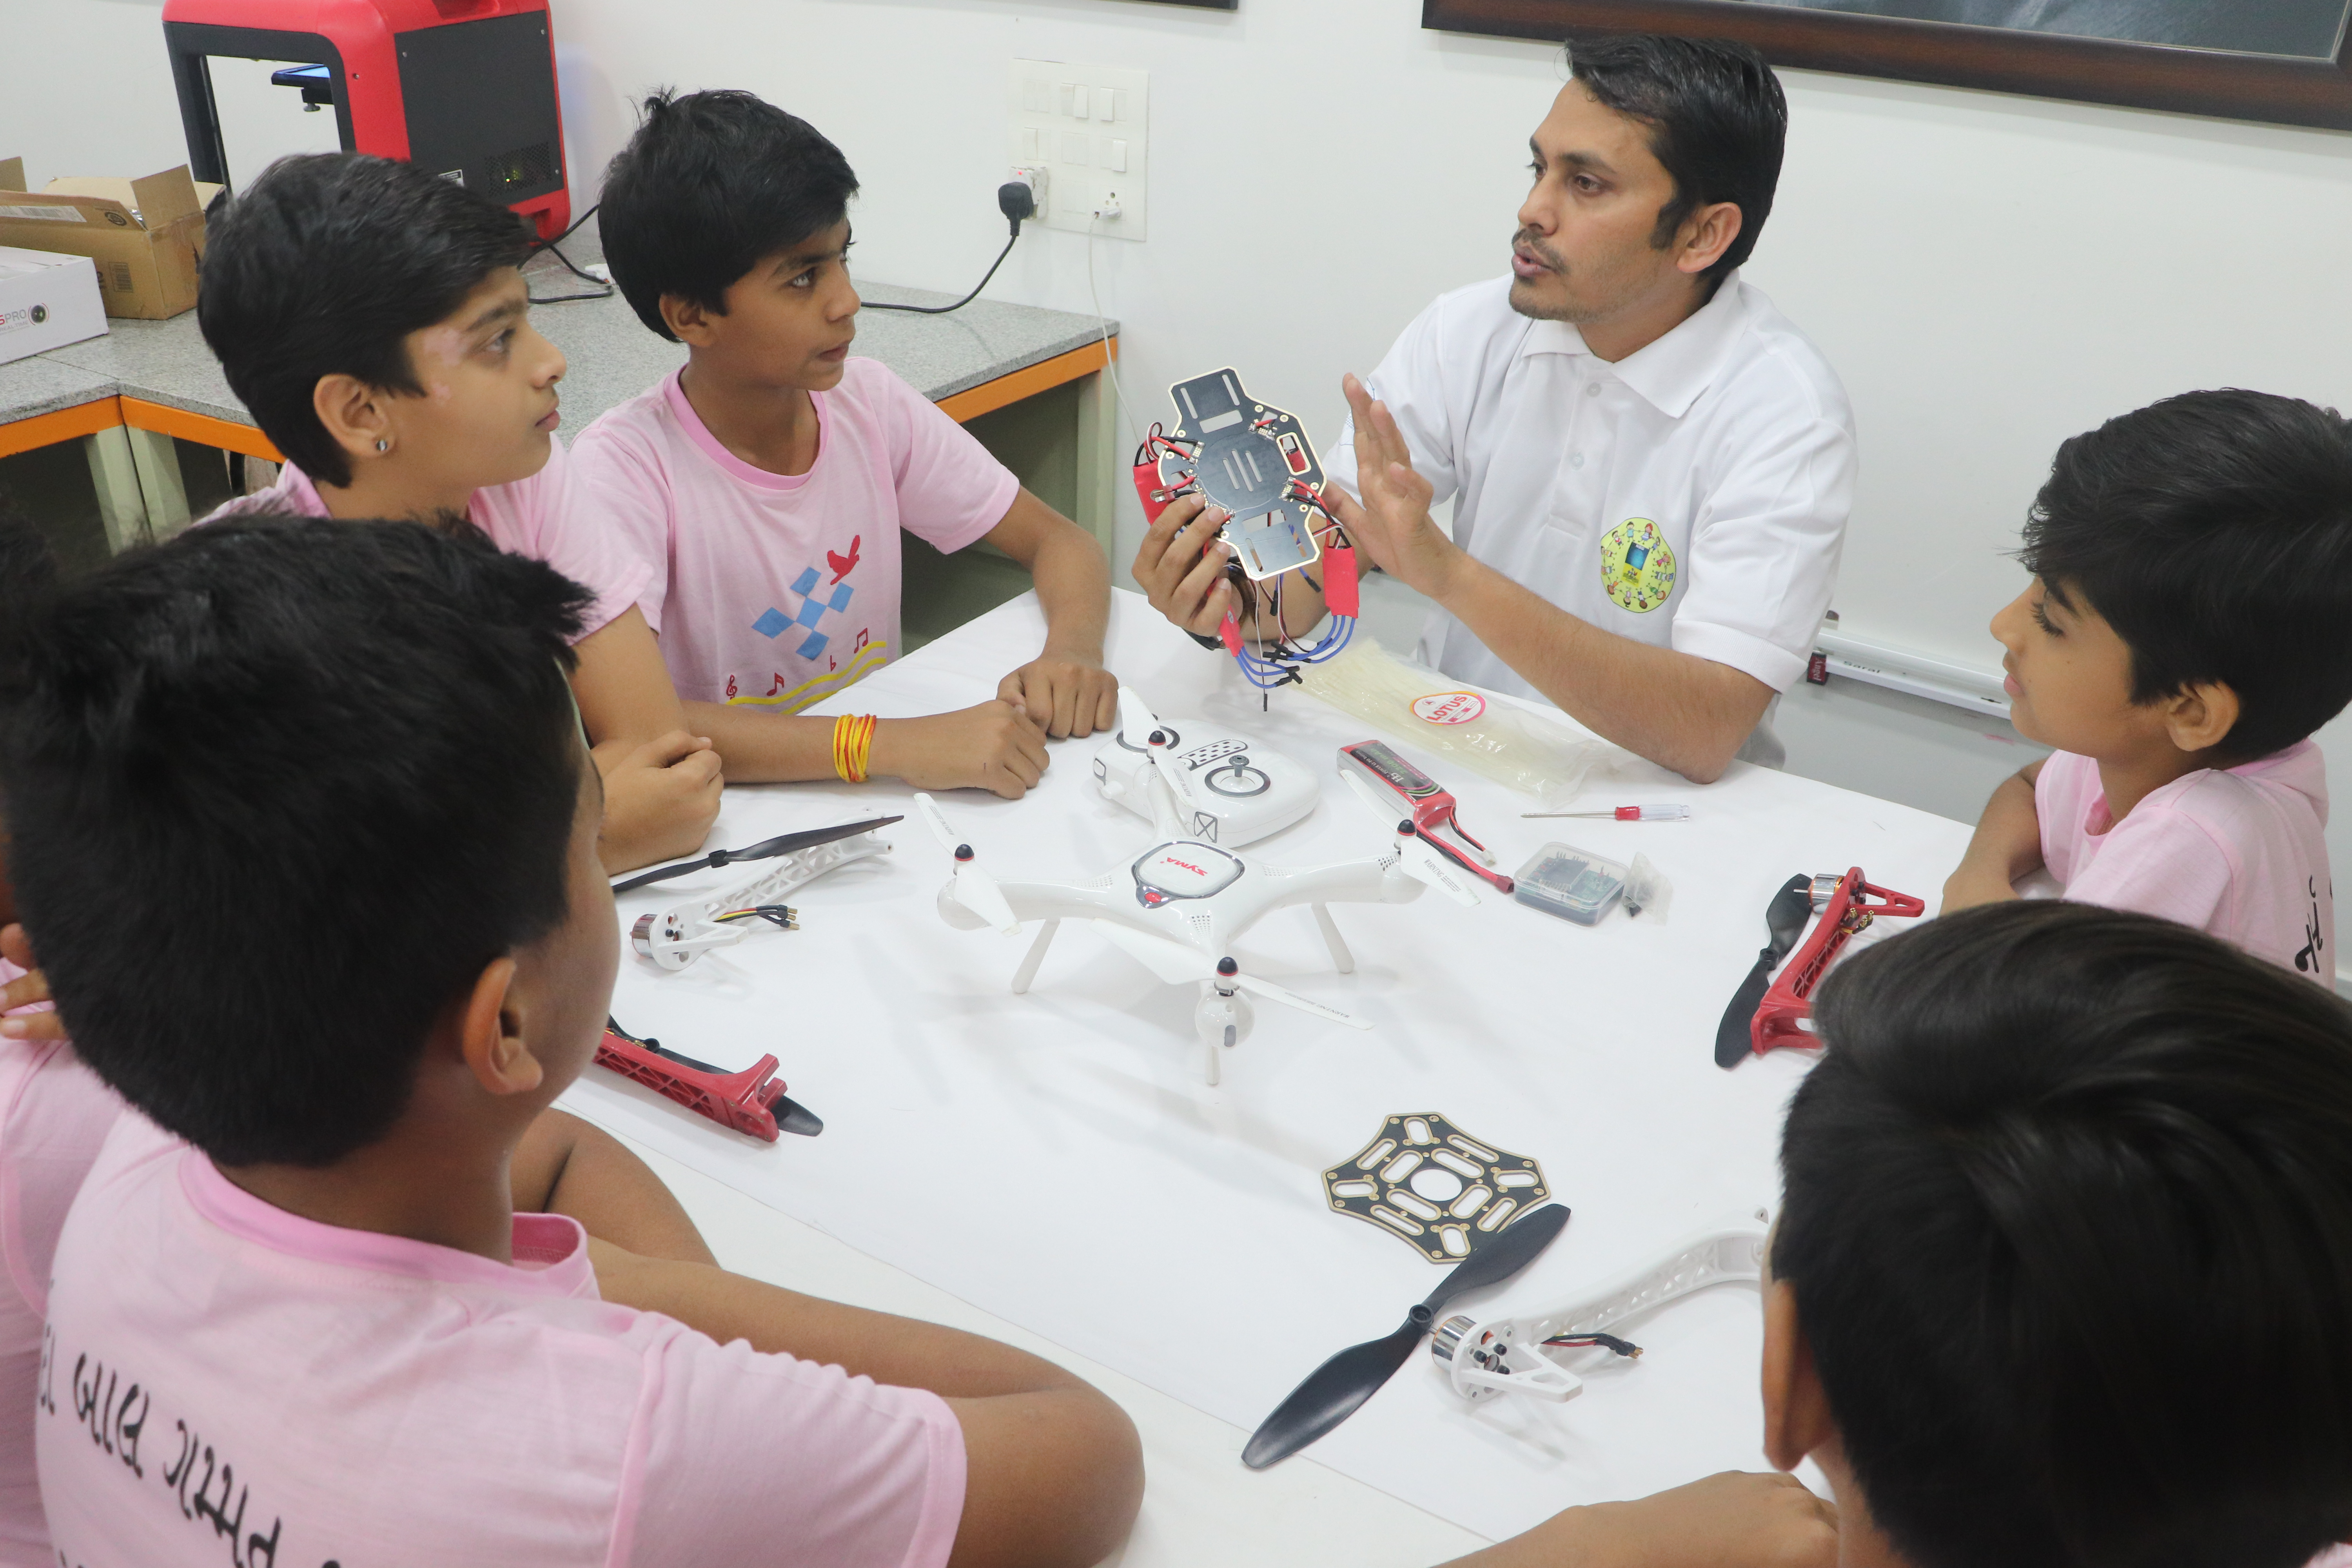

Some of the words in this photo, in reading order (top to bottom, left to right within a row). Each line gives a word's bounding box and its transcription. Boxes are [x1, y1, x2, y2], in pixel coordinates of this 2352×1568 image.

[1426, 696, 1468, 721] LOTUS
[1167, 857, 1208, 876] SYMA
[1424, 858, 1444, 877] WARNING
[1316, 1004, 1350, 1018] WARNING
